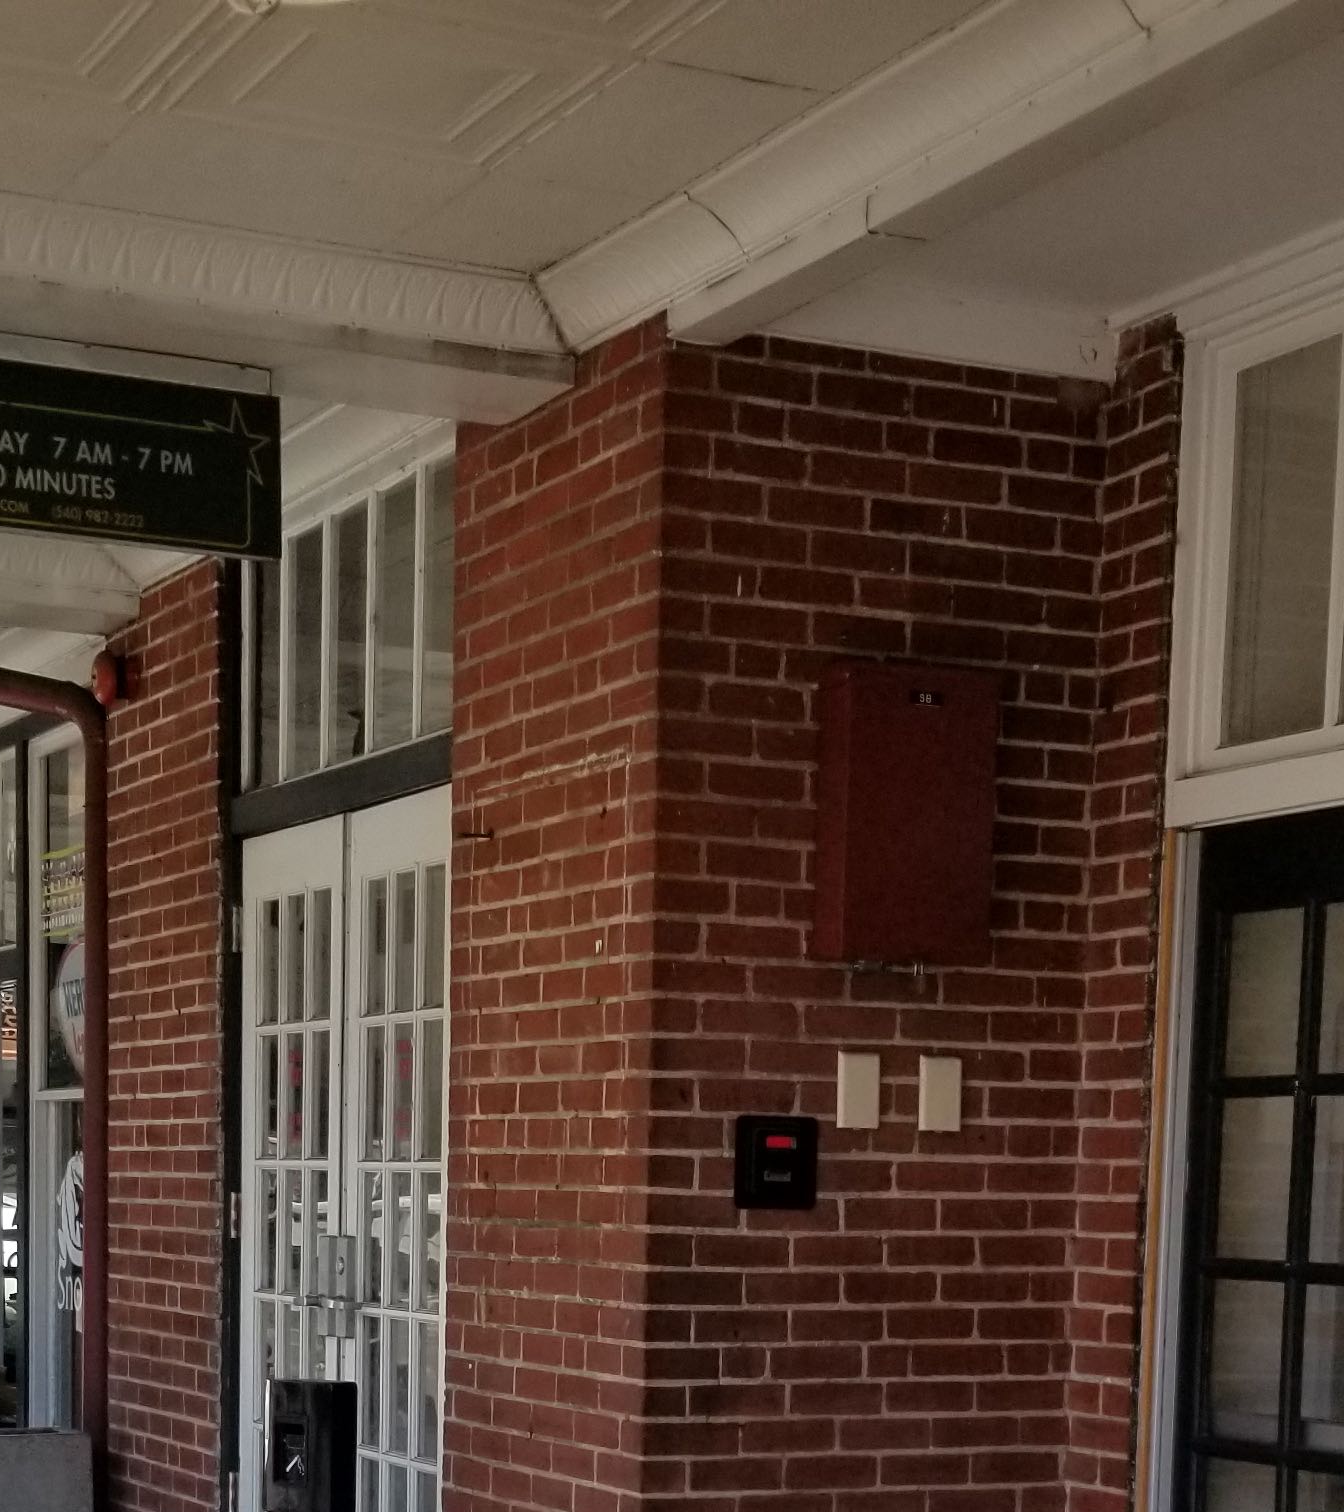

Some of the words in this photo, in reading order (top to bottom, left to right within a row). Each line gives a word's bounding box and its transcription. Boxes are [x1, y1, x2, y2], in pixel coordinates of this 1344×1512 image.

[52, 436, 67, 459] 7
[76, 440, 113, 465] AM
[136, 447, 151, 471] 7
[160, 450, 194, 476] PM
[15, 465, 116, 500] MINUTES
